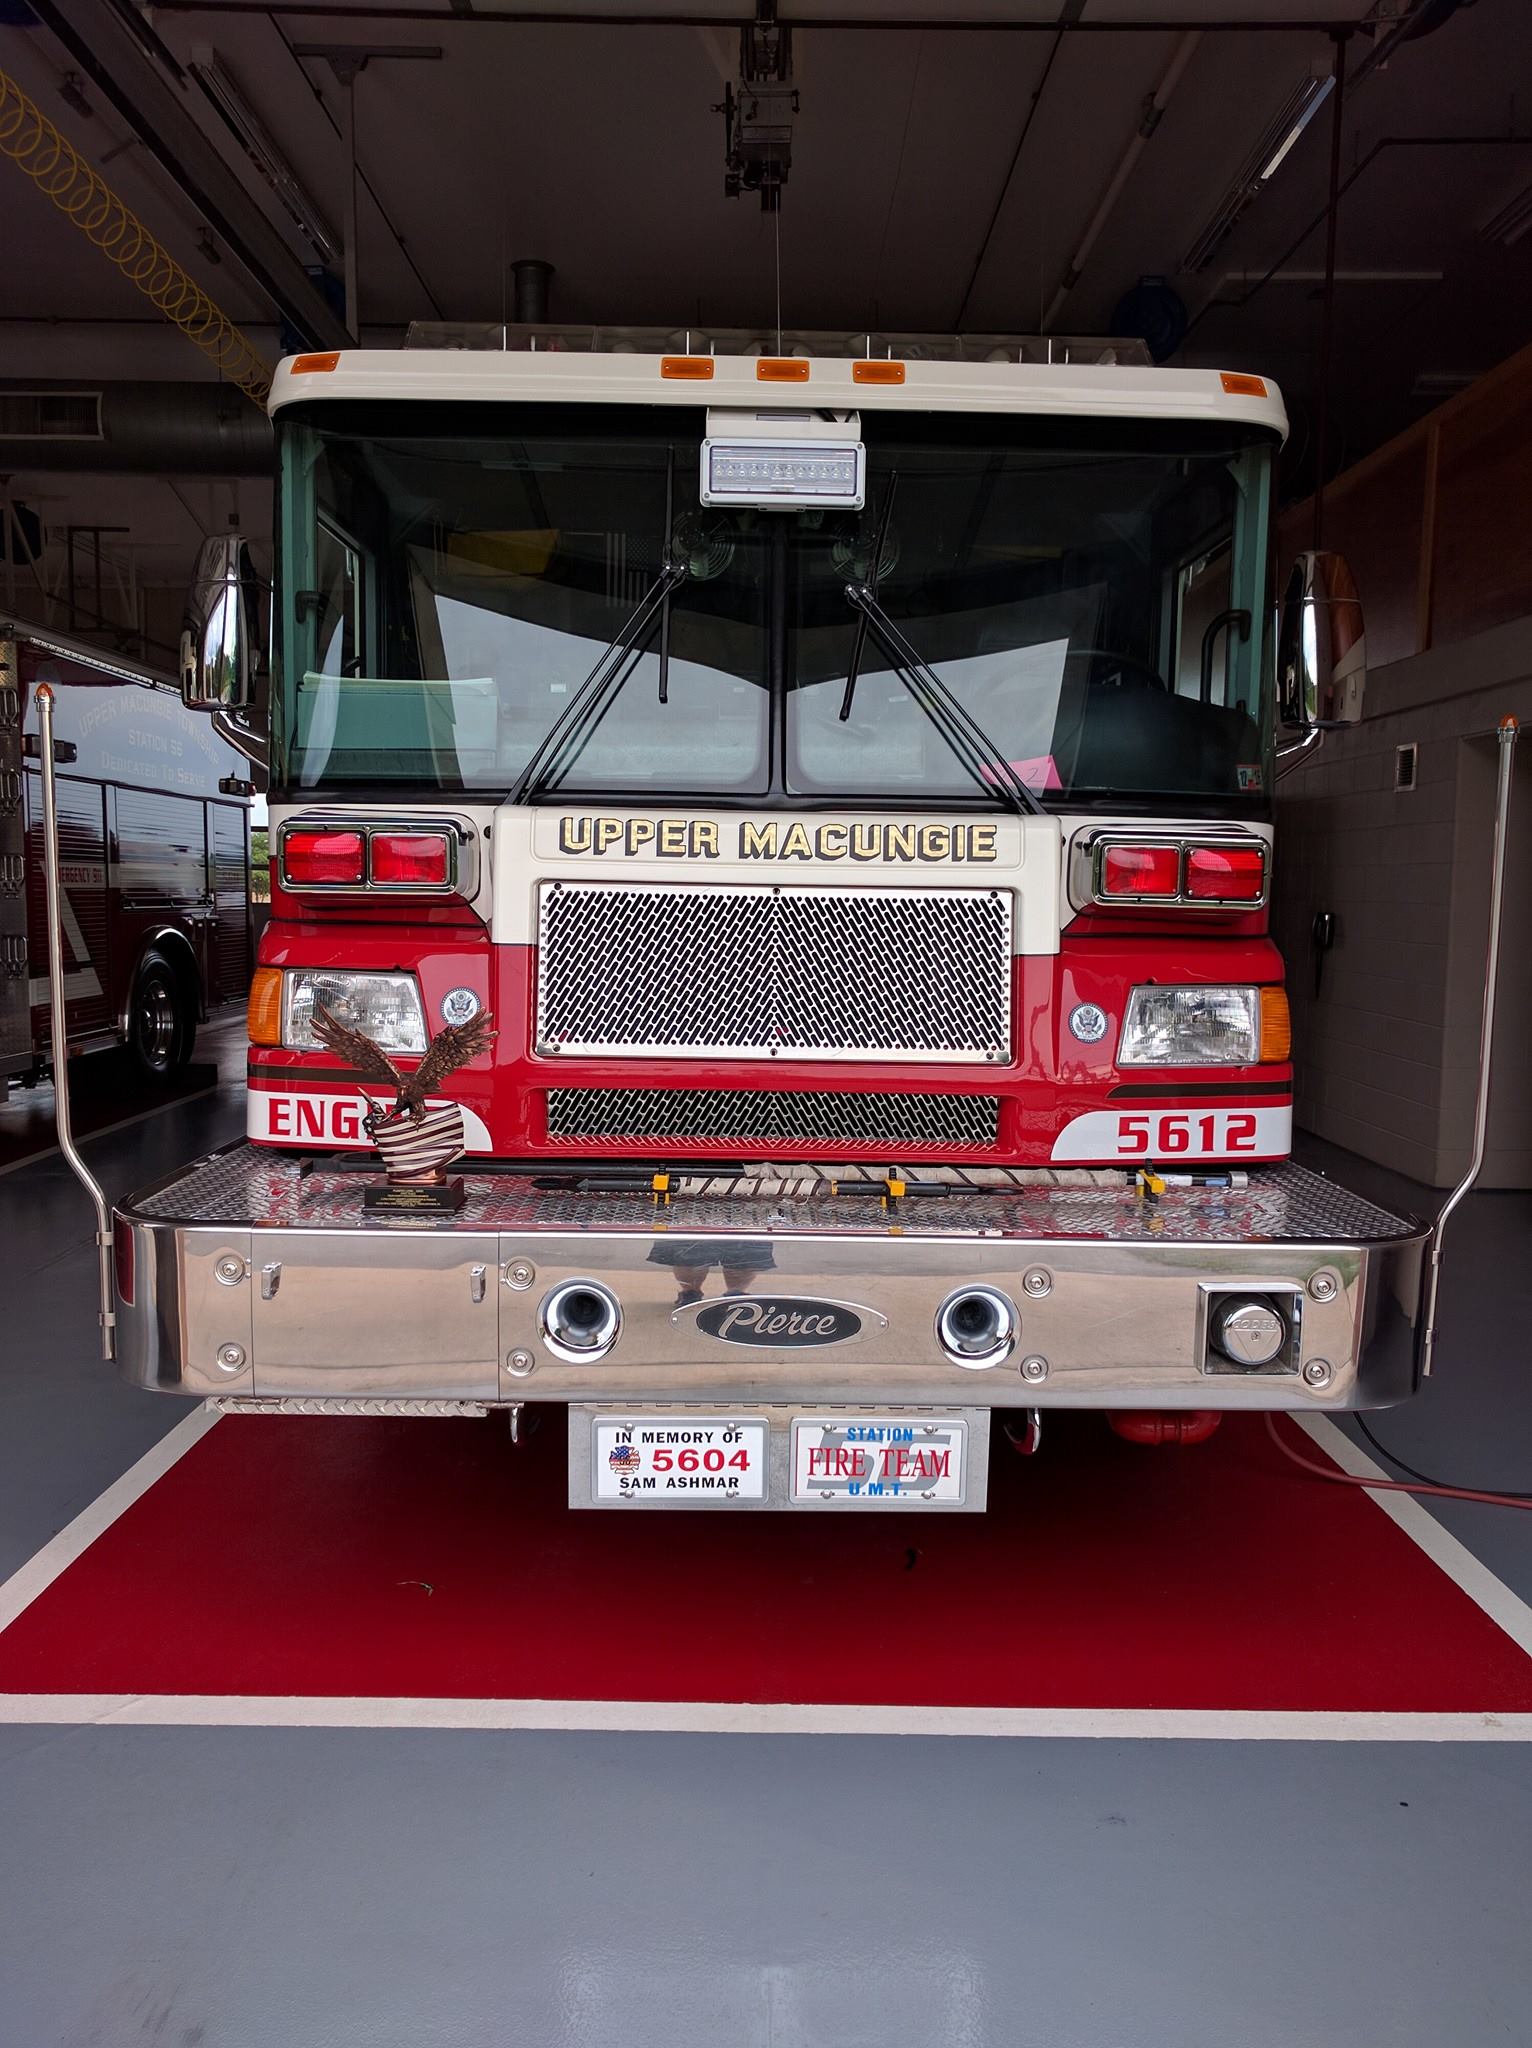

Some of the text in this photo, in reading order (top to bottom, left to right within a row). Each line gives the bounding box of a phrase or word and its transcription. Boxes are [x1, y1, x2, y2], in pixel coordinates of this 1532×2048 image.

[79, 700, 117, 737] UPPER
[128, 729, 168, 753] STATION
[559, 817, 998, 863] UPPER MACUNGIE
[1117, 1115, 1257, 1153] 5612
[717, 1302, 837, 1338] Pierce
[615, 1431, 744, 1444] IN MEMORY OF
[846, 1427, 914, 1442] STATION
[652, 1448, 751, 1472] 5604
[807, 1446, 952, 1478] FIRE TEAM
[619, 1476, 740, 1489] SAM ASHMAR
[848, 1481, 908, 1497] U.M.T.
